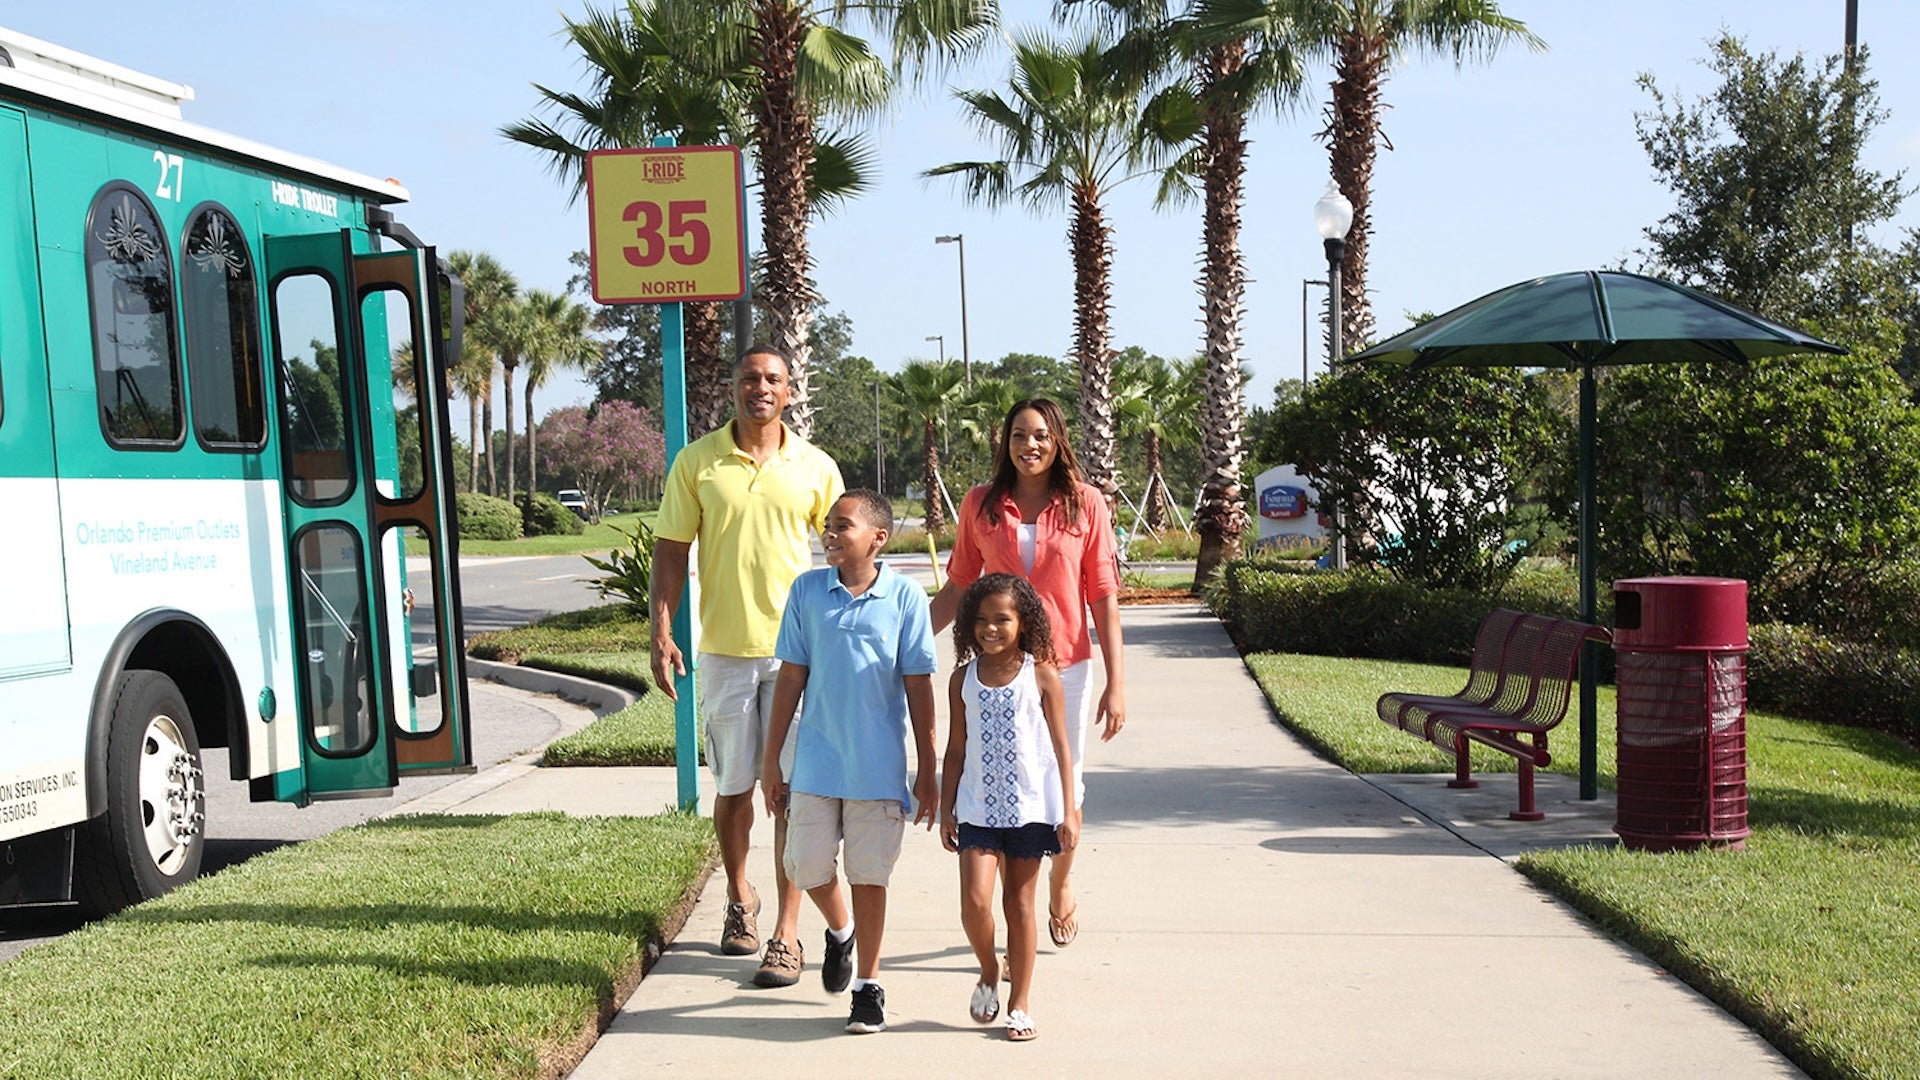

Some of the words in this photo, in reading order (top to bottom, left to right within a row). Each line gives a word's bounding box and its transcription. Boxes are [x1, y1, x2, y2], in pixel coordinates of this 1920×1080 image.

[153, 150, 184, 203] 27
[272, 181, 300, 209] I-RIDE
[301, 189, 337, 217] TROLLEY
[622, 200, 711, 267] 35
[642, 280, 696, 295] NORTH
[77, 520, 134, 544] Orlando
[138, 520, 194, 542] Premium
[197, 519, 240, 540] Outlets
[110, 549, 169, 574] Vineland
[172, 549, 217, 571] Avenue
[14, 775, 61, 799] SERVICES,
[62, 770, 79, 788] INC.
